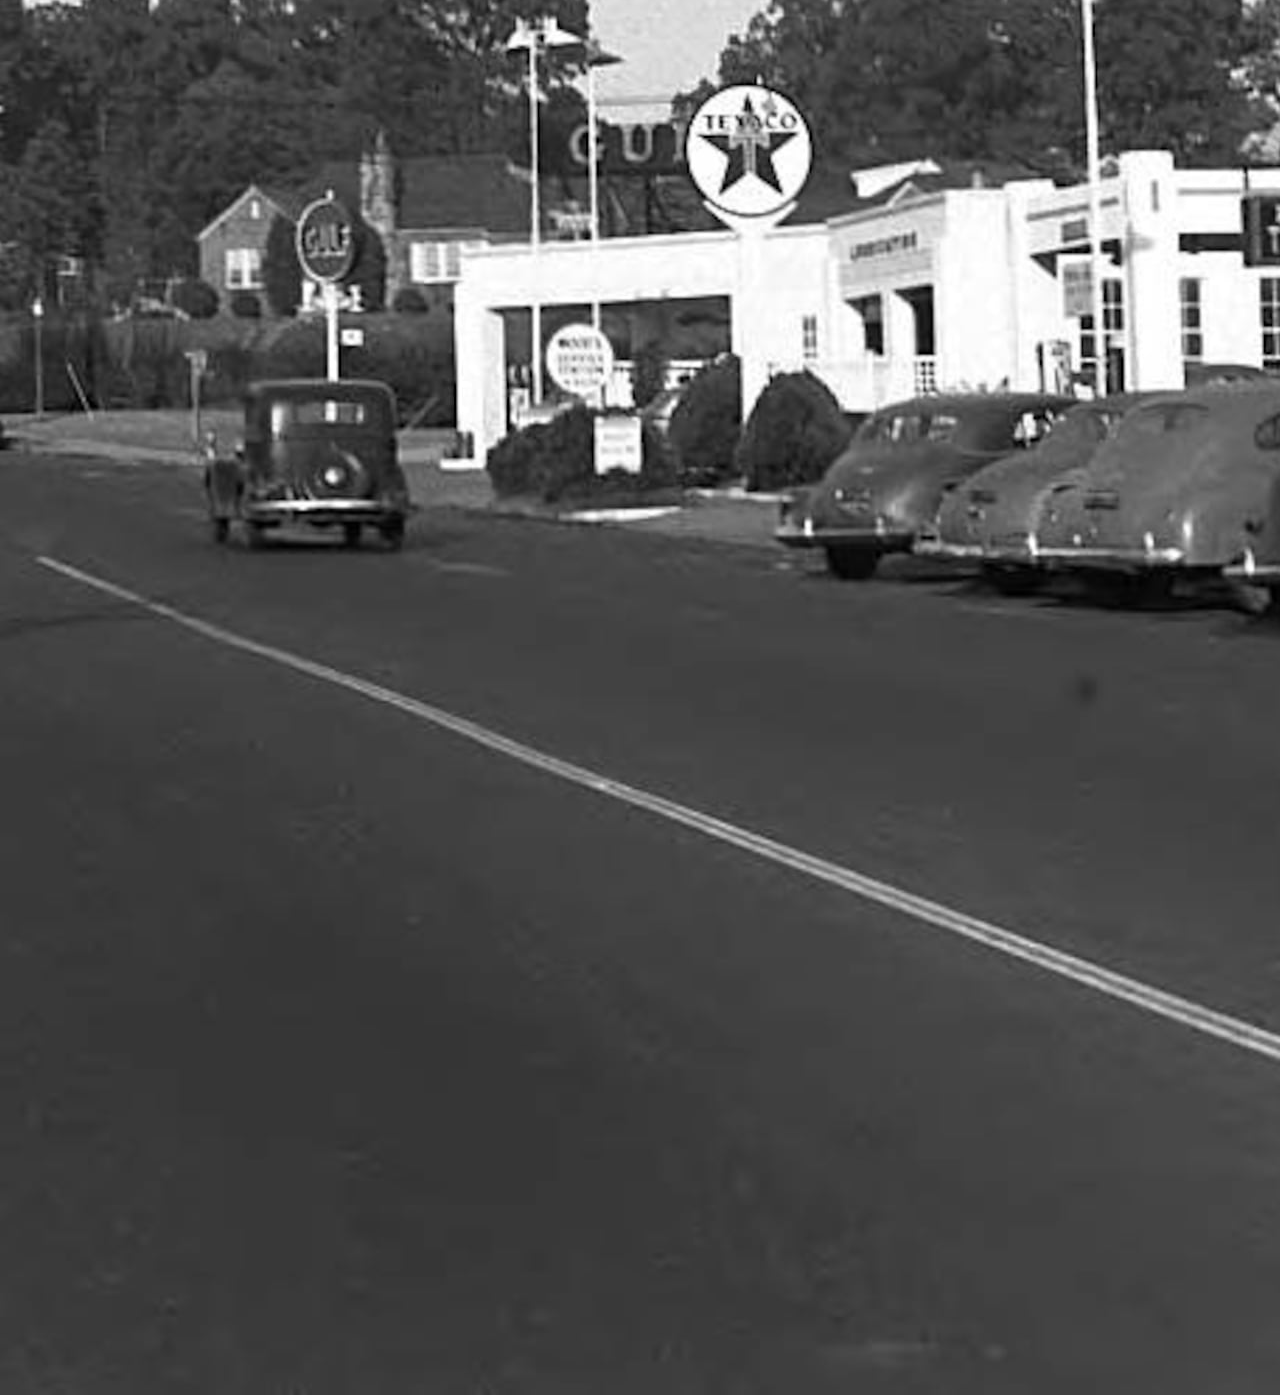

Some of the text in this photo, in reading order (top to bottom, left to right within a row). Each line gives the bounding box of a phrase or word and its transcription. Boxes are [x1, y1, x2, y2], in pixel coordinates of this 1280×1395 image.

[702, 113, 798, 131] TEXACO
[570, 121, 688, 164] GU
[305, 223, 352, 258] GULF
